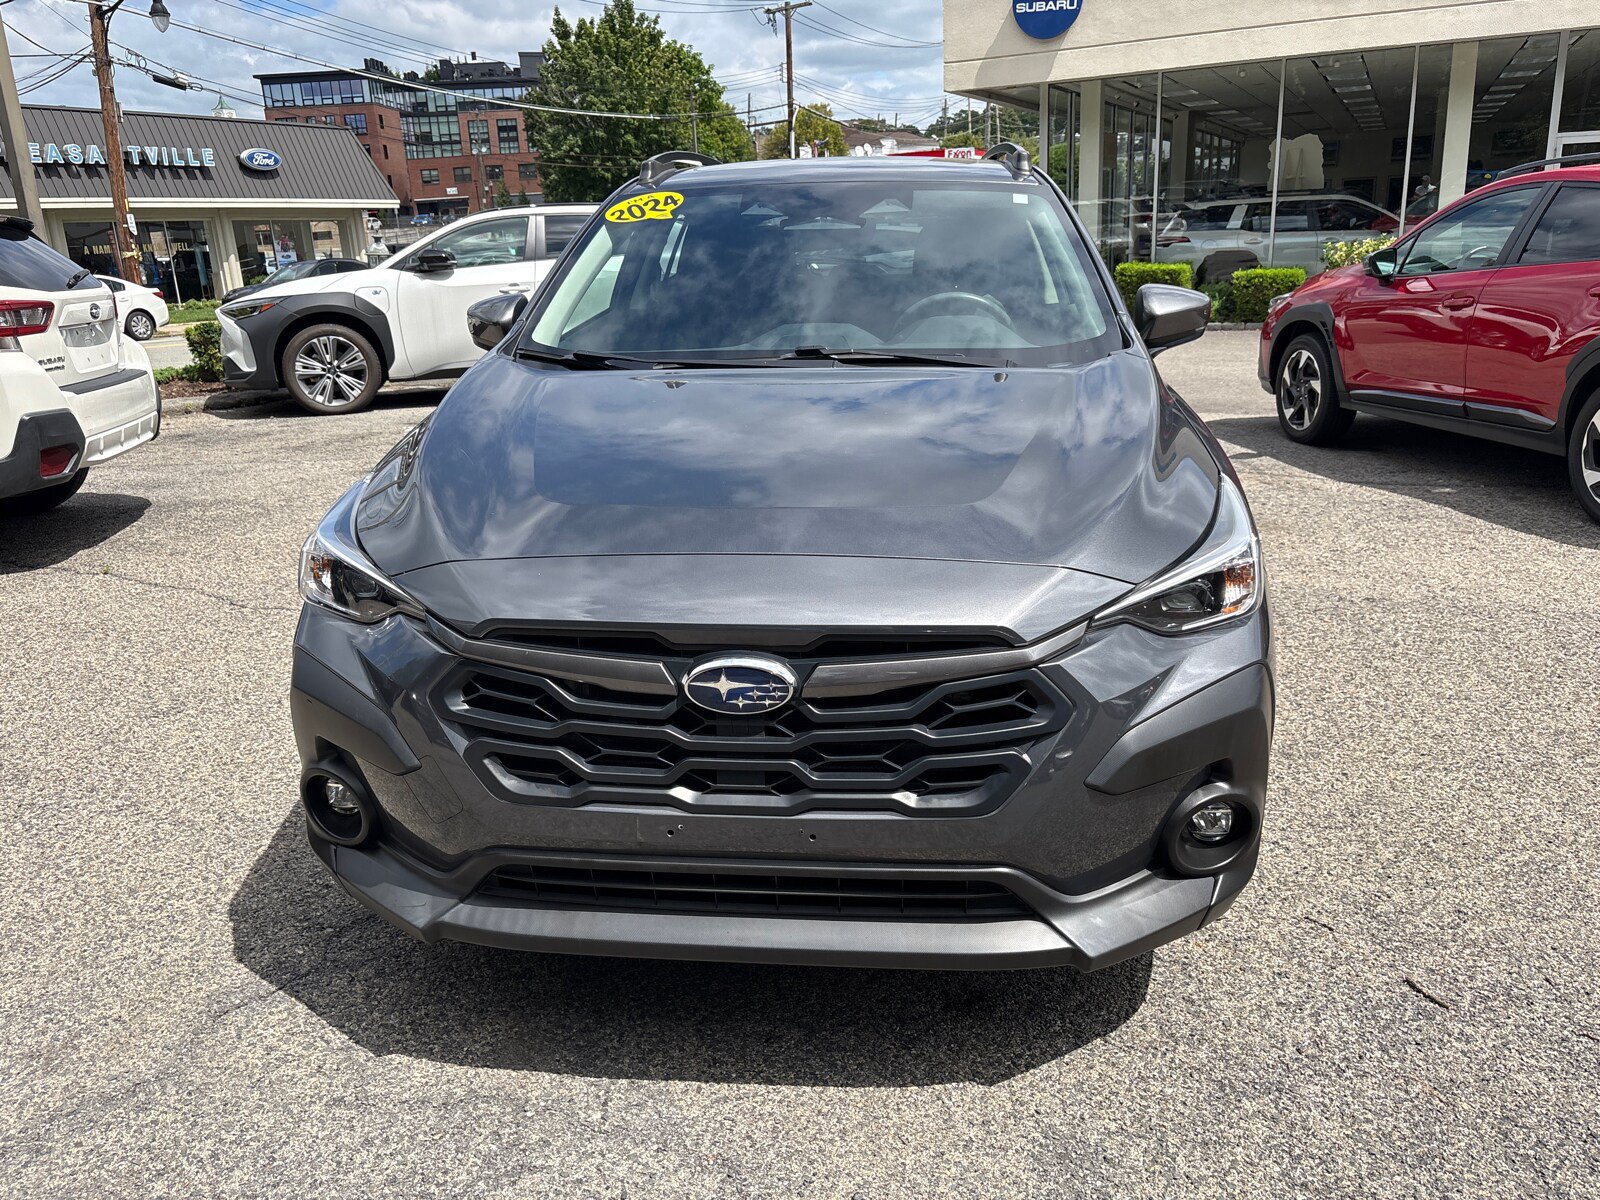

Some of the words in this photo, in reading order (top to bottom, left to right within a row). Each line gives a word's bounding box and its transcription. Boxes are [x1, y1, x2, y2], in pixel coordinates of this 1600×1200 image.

[1015, 0, 1078, 13] SUBARU
[0, 142, 215, 167] EASATVILLE
[252, 152, 276, 166] Ford
[610, 195, 681, 221] 2024
[92, 244, 113, 255] NAM
